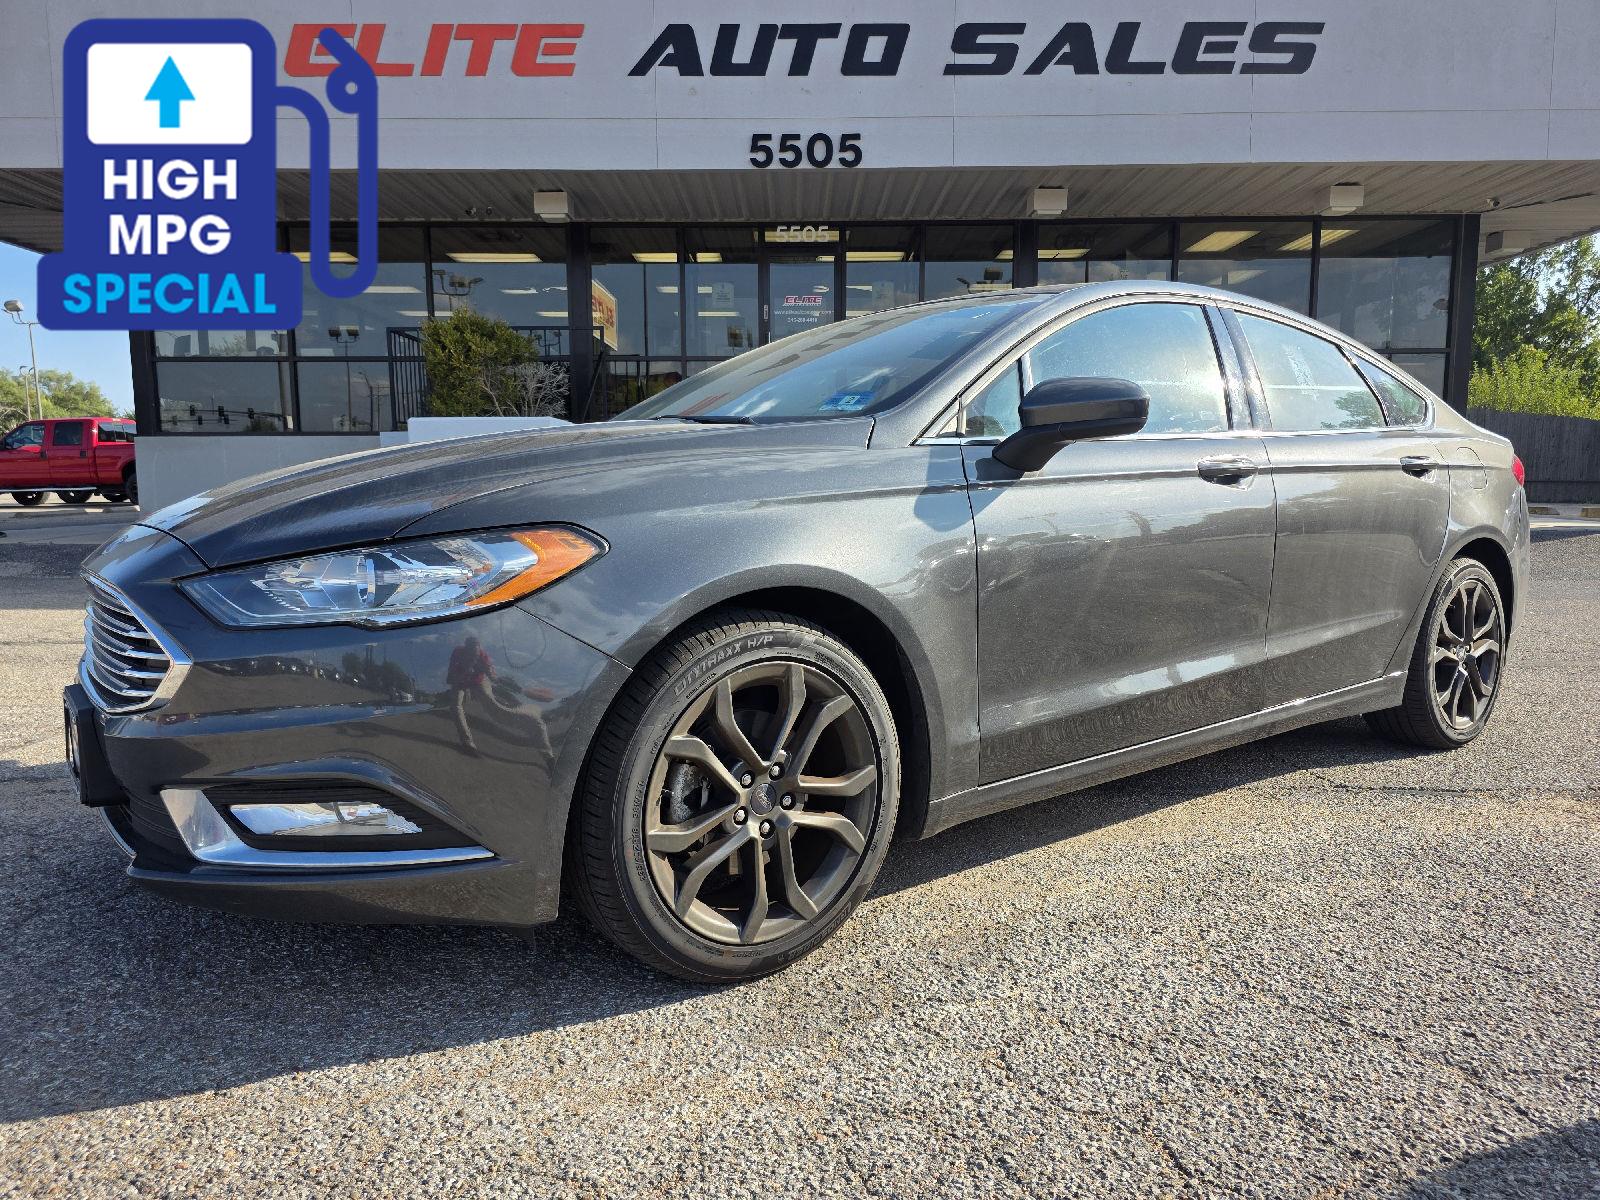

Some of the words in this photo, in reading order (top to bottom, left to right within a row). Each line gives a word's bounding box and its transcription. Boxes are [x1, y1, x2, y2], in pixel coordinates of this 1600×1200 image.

[284, 23, 585, 77] ELITE
[628, 22, 911, 77] AUTO
[943, 21, 1326, 76] SALES
[750, 132, 863, 170] 5505
[776, 225, 830, 243] 5505
[784, 295, 823, 304] ELITE
[747, 634, 774, 649] H/P
